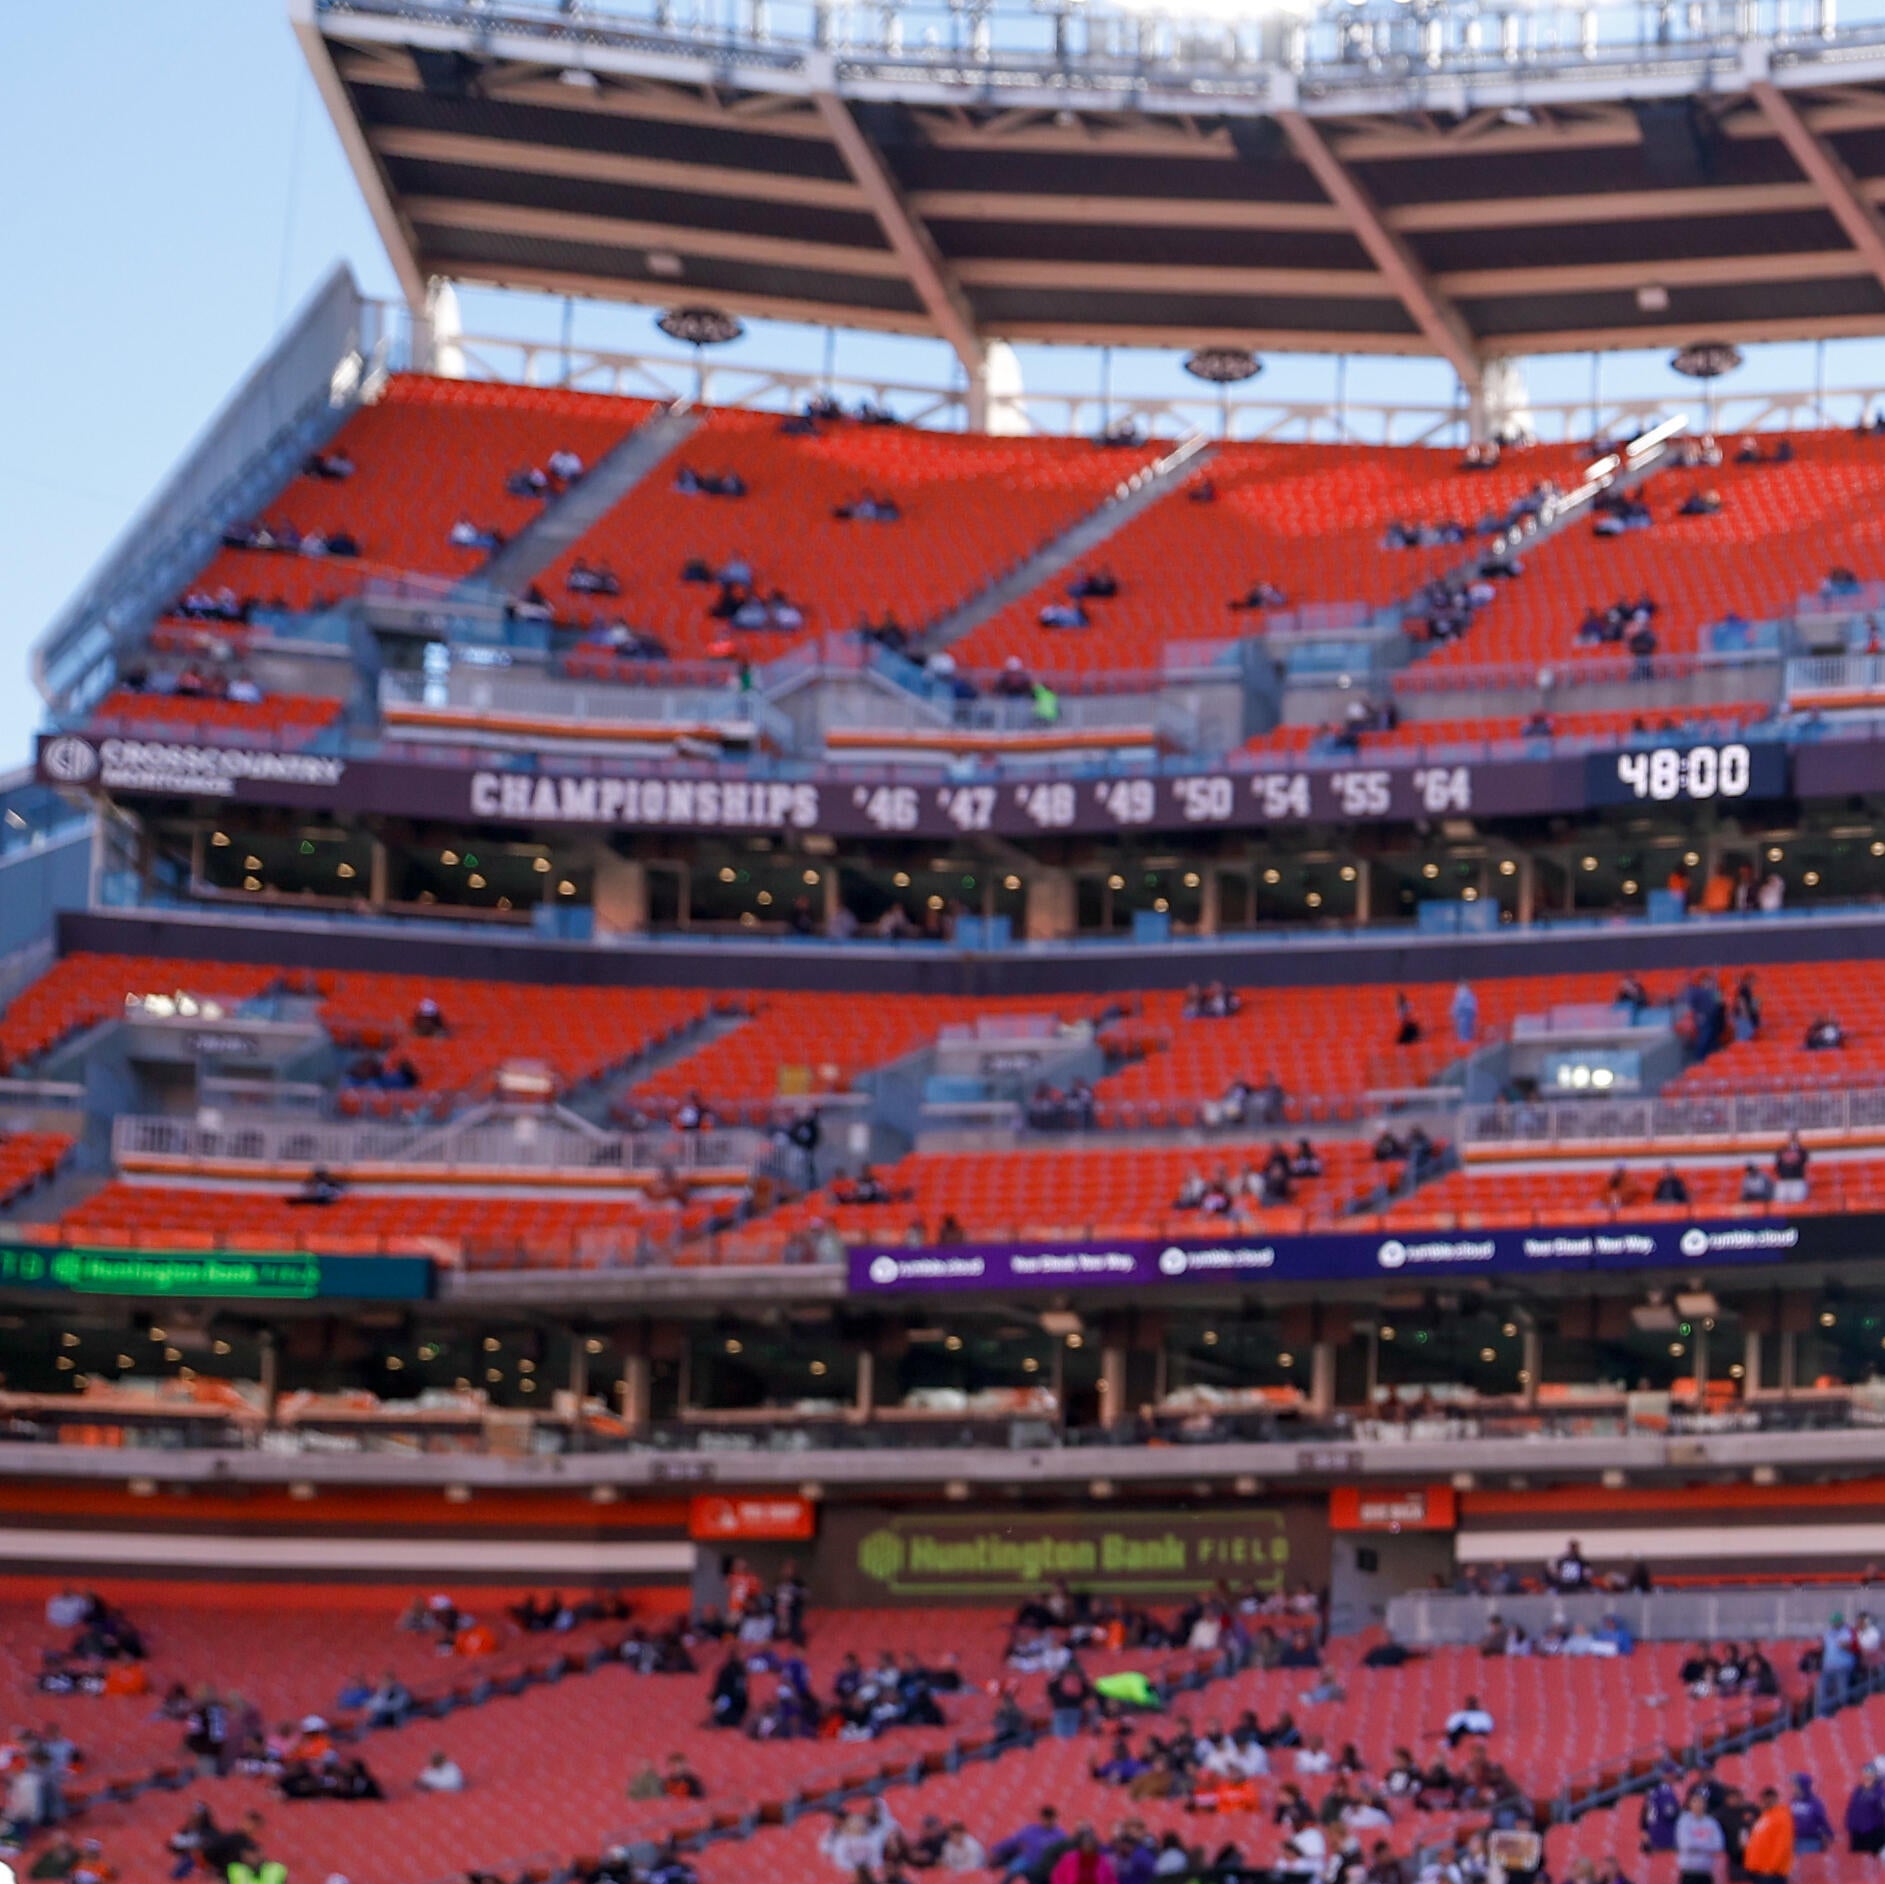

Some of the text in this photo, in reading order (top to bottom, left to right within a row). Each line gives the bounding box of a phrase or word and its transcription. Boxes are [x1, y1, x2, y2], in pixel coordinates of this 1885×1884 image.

[471, 768, 1470, 830] CHAMPIONSHIPS '46 '47 '48 '49 '50 '54 '55 '64
[1618, 744, 1750, 800] 48:00
[910, 1532, 1289, 1581] Huntington Bank FIELD
